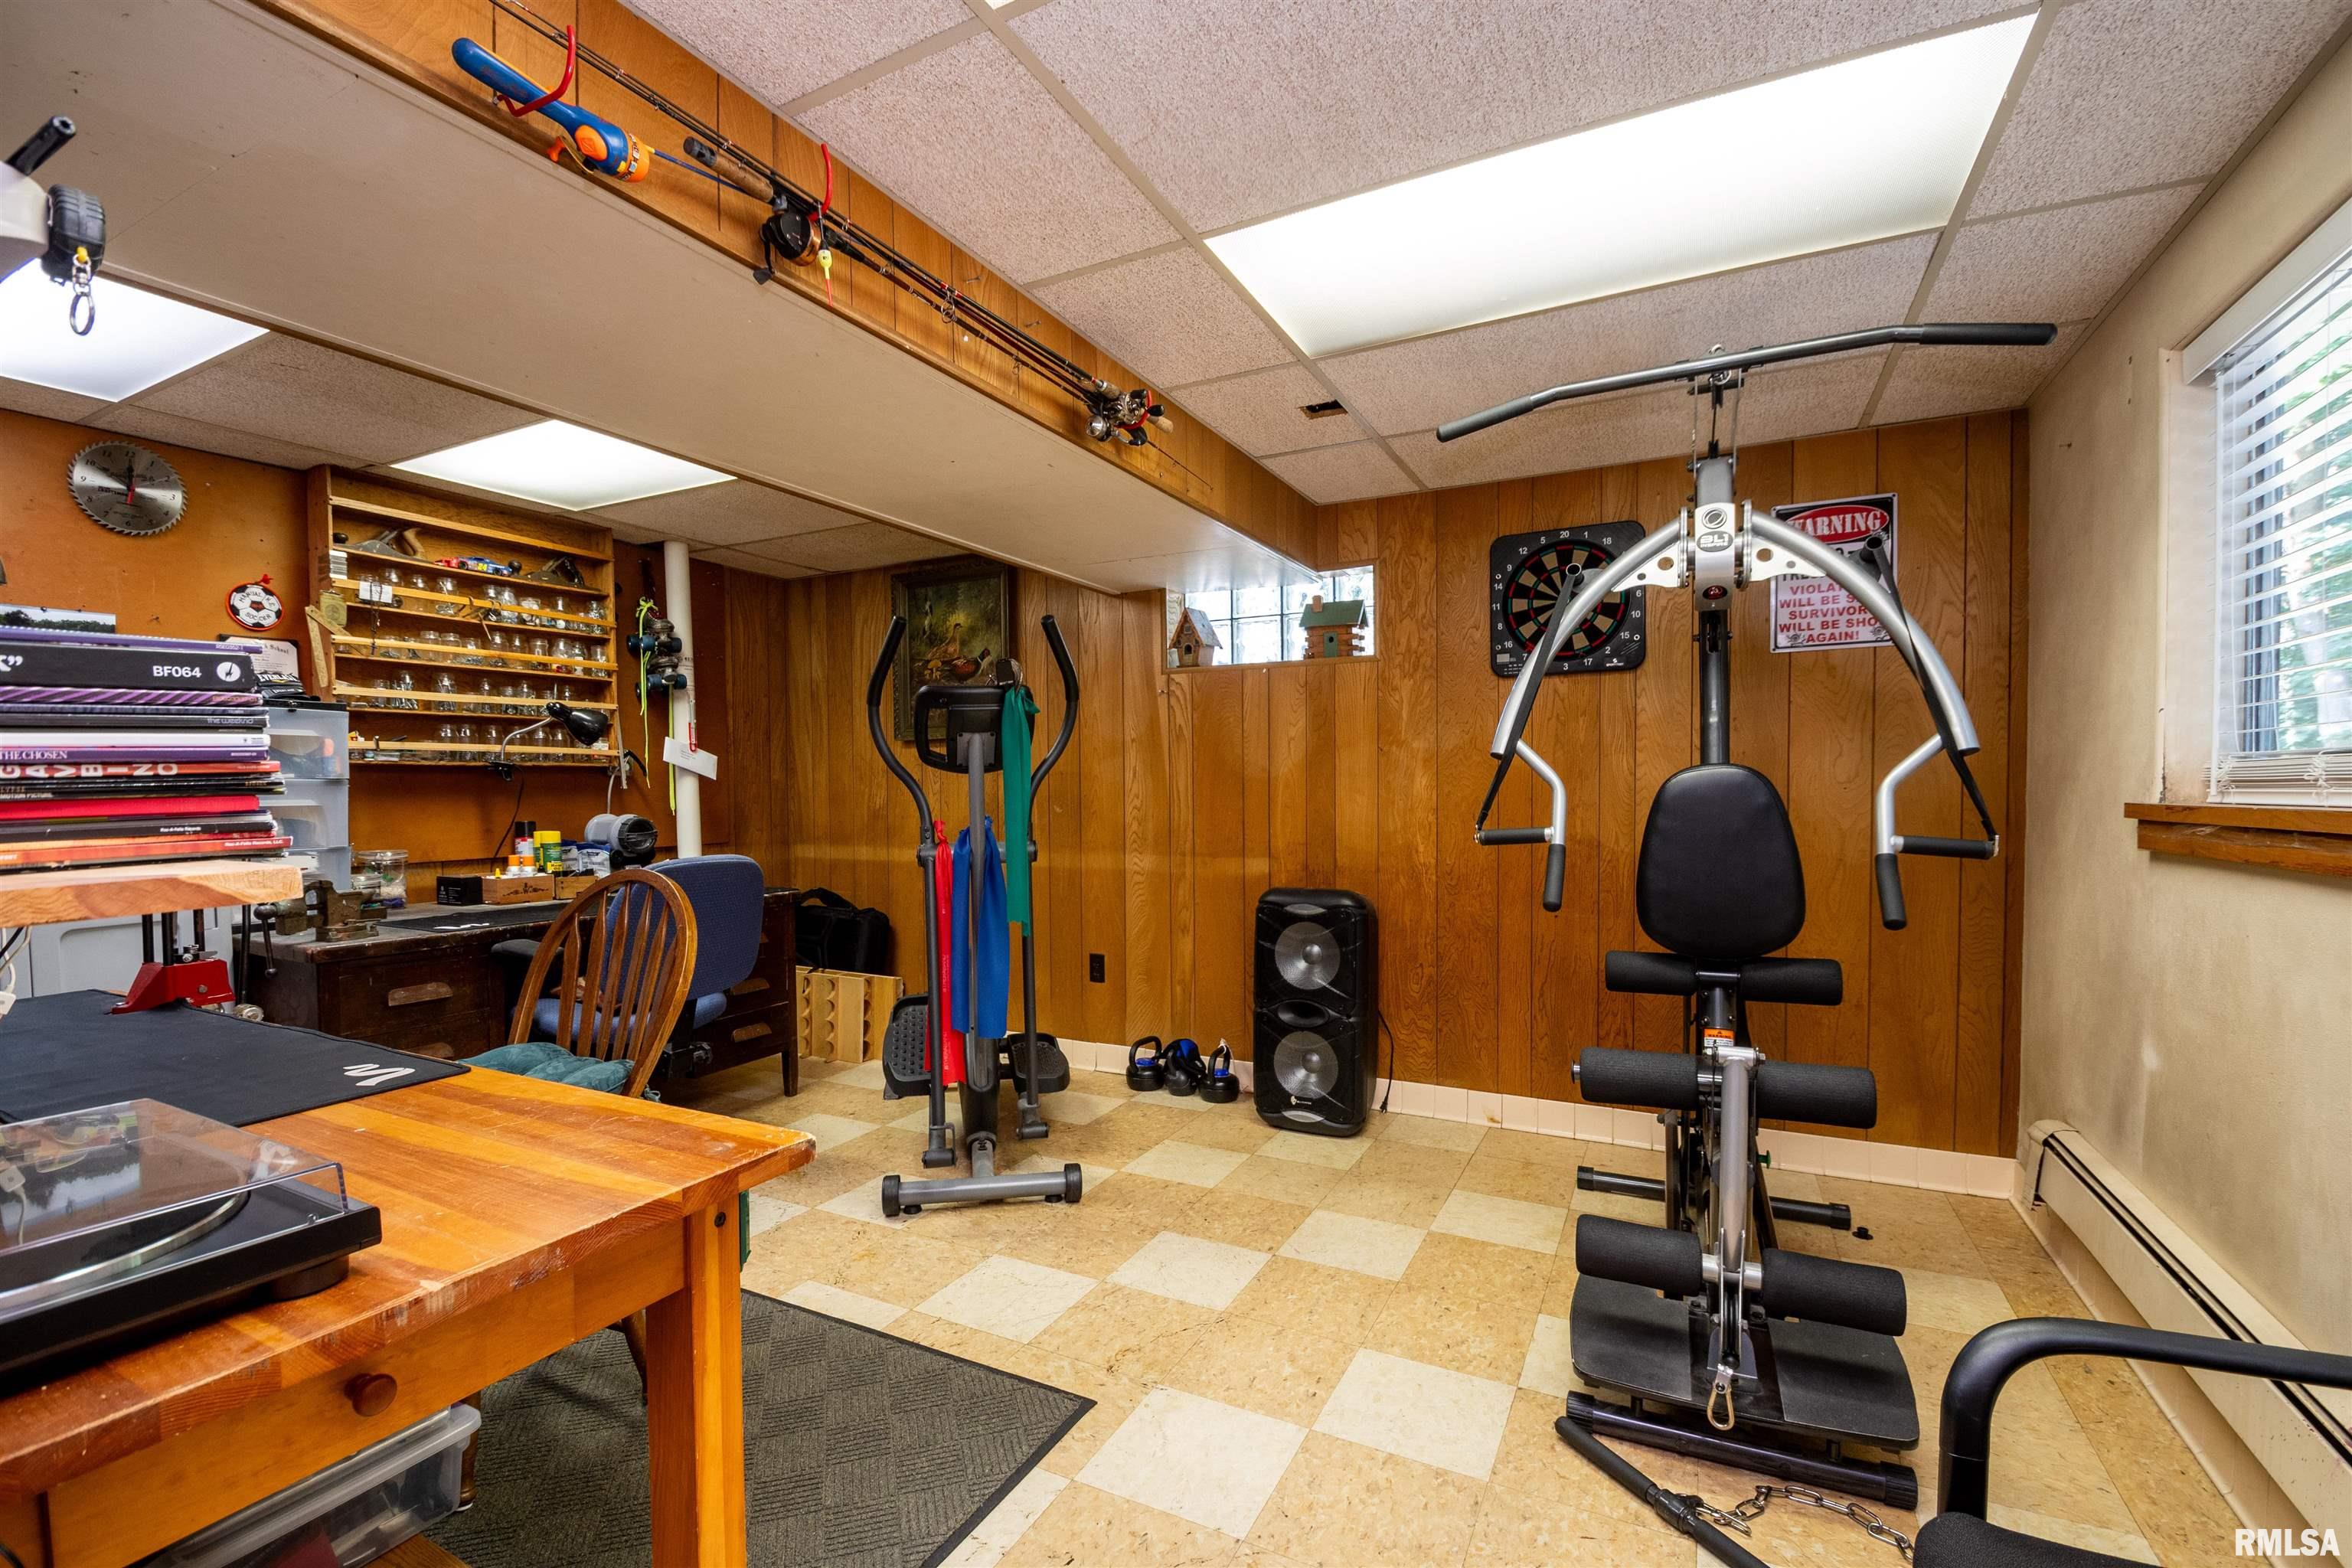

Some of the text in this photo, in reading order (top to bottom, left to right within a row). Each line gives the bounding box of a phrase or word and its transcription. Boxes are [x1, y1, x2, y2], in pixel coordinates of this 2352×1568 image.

[1779, 597, 1814, 609] WILL
[1821, 595, 1841, 605] BE
[1788, 606, 1868, 620] SURVIVOR
[1779, 616, 1877, 633] WILL BE SHO
[1805, 631, 1860, 643] AGAIN!
[152, 665, 201, 678] BF064
[22, 750, 68, 760] CHOSEN
